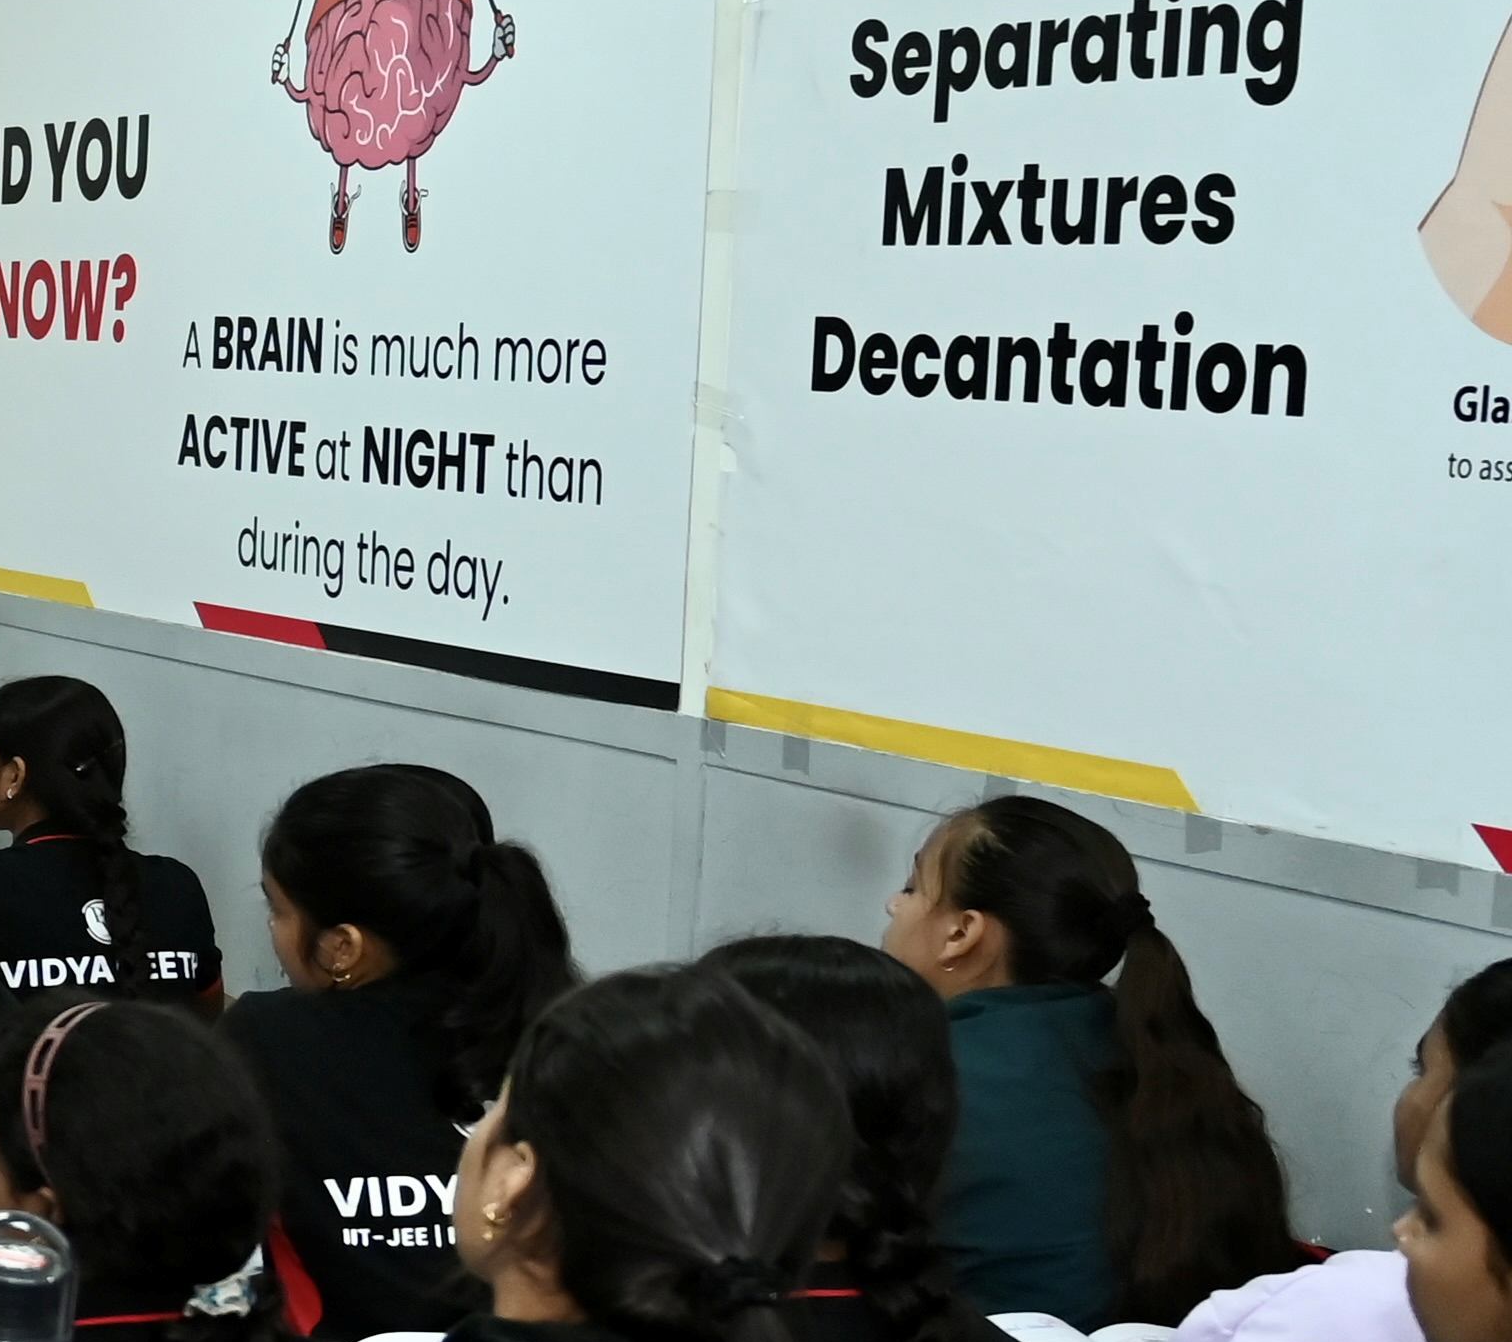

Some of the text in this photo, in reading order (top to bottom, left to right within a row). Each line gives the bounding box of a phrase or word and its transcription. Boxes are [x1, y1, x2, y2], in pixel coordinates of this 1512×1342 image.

[44, 114, 149, 203] YOU
[881, 154, 1238, 248] Mixtures
[183, 316, 607, 387] A BRAIN is much more
[810, 311, 1308, 417] Decantation
[1453, 385, 1512, 424] Gla
[177, 414, 604, 505] ACTIVE at NIGHT than
[1448, 453, 1512, 482] to ass
[237, 516, 511, 620] during the day.
[323, 1173, 458, 1218] VIDY
[342, 1227, 429, 1247] IIT-JEE
